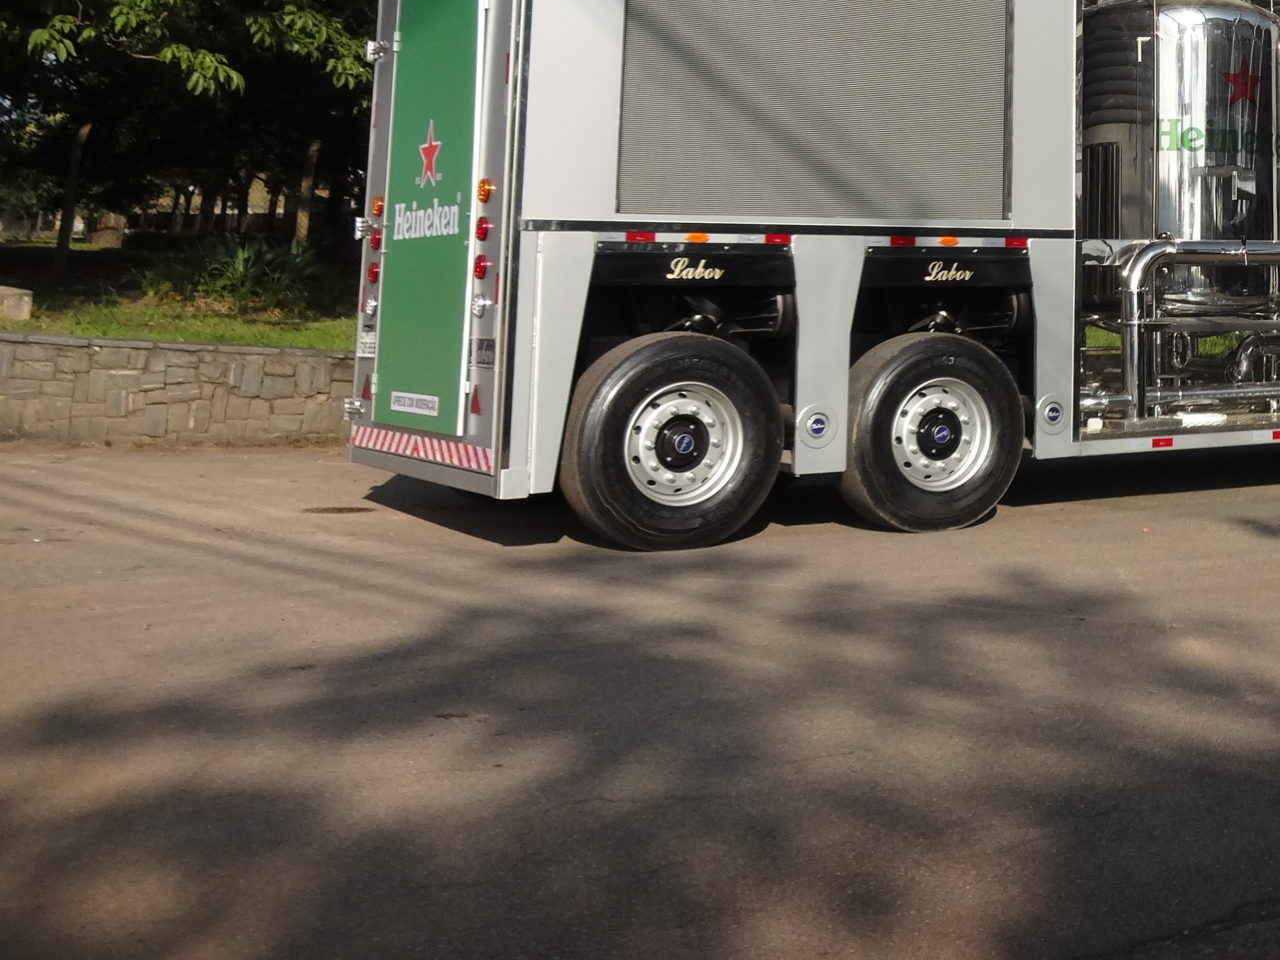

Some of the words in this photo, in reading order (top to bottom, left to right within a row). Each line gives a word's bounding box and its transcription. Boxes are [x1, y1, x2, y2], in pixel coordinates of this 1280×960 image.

[393, 198, 460, 240] Heineken
[666, 257, 726, 280] Labor
[924, 261, 974, 281] Labor
